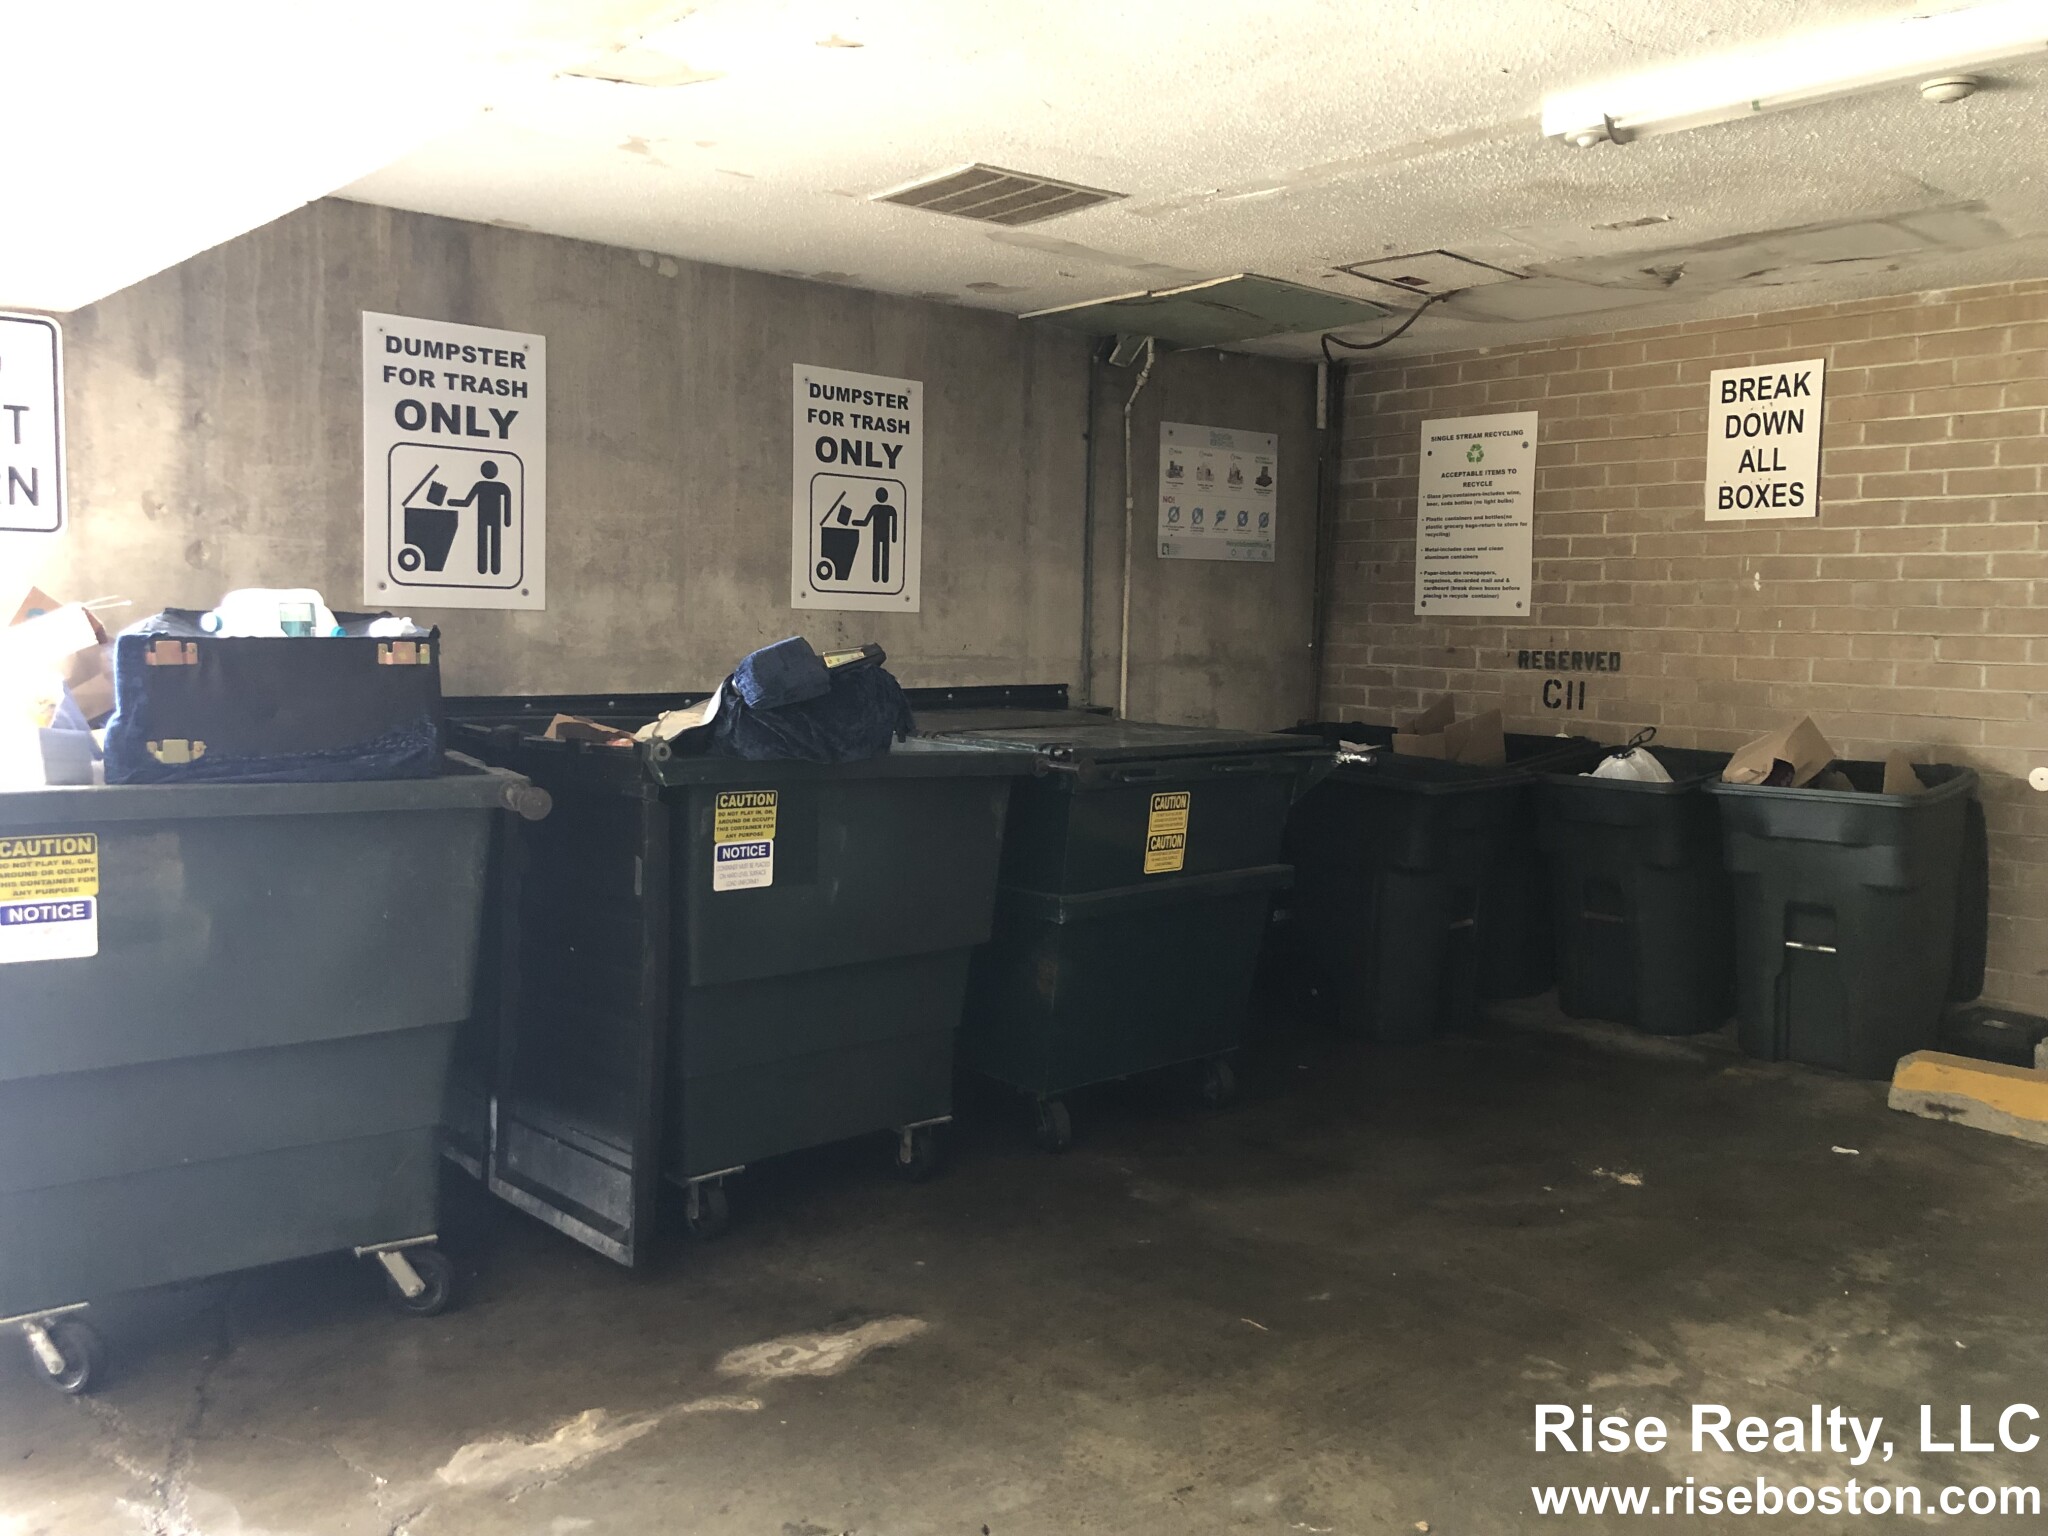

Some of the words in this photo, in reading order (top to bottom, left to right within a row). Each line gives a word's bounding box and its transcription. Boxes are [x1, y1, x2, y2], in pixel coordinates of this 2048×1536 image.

[385, 335, 526, 369] DUMPSTER
[383, 365, 436, 388] FOR
[444, 372, 529, 399] TRASH
[1721, 371, 1812, 404] BREAK
[808, 382, 910, 410] DUMPSTER
[394, 398, 519, 440] ONLY
[807, 408, 844, 428] FOR
[851, 413, 911, 435] TRASH
[1725, 409, 1804, 439] DOWN
[1431, 434, 1454, 442] SINGLE
[1456, 432, 1483, 440] STREAM
[1484, 429, 1524, 438] RECYCLING
[814, 436, 904, 470] ONLY
[1738, 447, 1787, 474] ALL
[1441, 470, 1483, 479] ACCEPTABLE
[1462, 480, 1493, 488] RECYCLE
[1718, 481, 1805, 510] BOXES
[1518, 649, 1621, 672] RESERVED
[720, 793, 775, 808] CAUTION
[1154, 794, 1187, 810] CAUTION
[0, 837, 92, 858] CAUTION
[722, 844, 766, 860] NOTICE
[1150, 834, 1183, 851] CAUTION
[12, 861, 33, 869] NOT
[35, 859, 59, 867] PLAY
[41, 868, 54, 876] OR
[57, 866, 96, 875] OCCUPY
[0, 879, 17, 888] HIS
[20, 877, 75, 887] CONTAINER
[77, 875, 96, 884] FOR
[12, 888, 33, 896] ANY
[35, 886, 80, 895] PURPOSE
[9, 903, 85, 923] NOTICE
